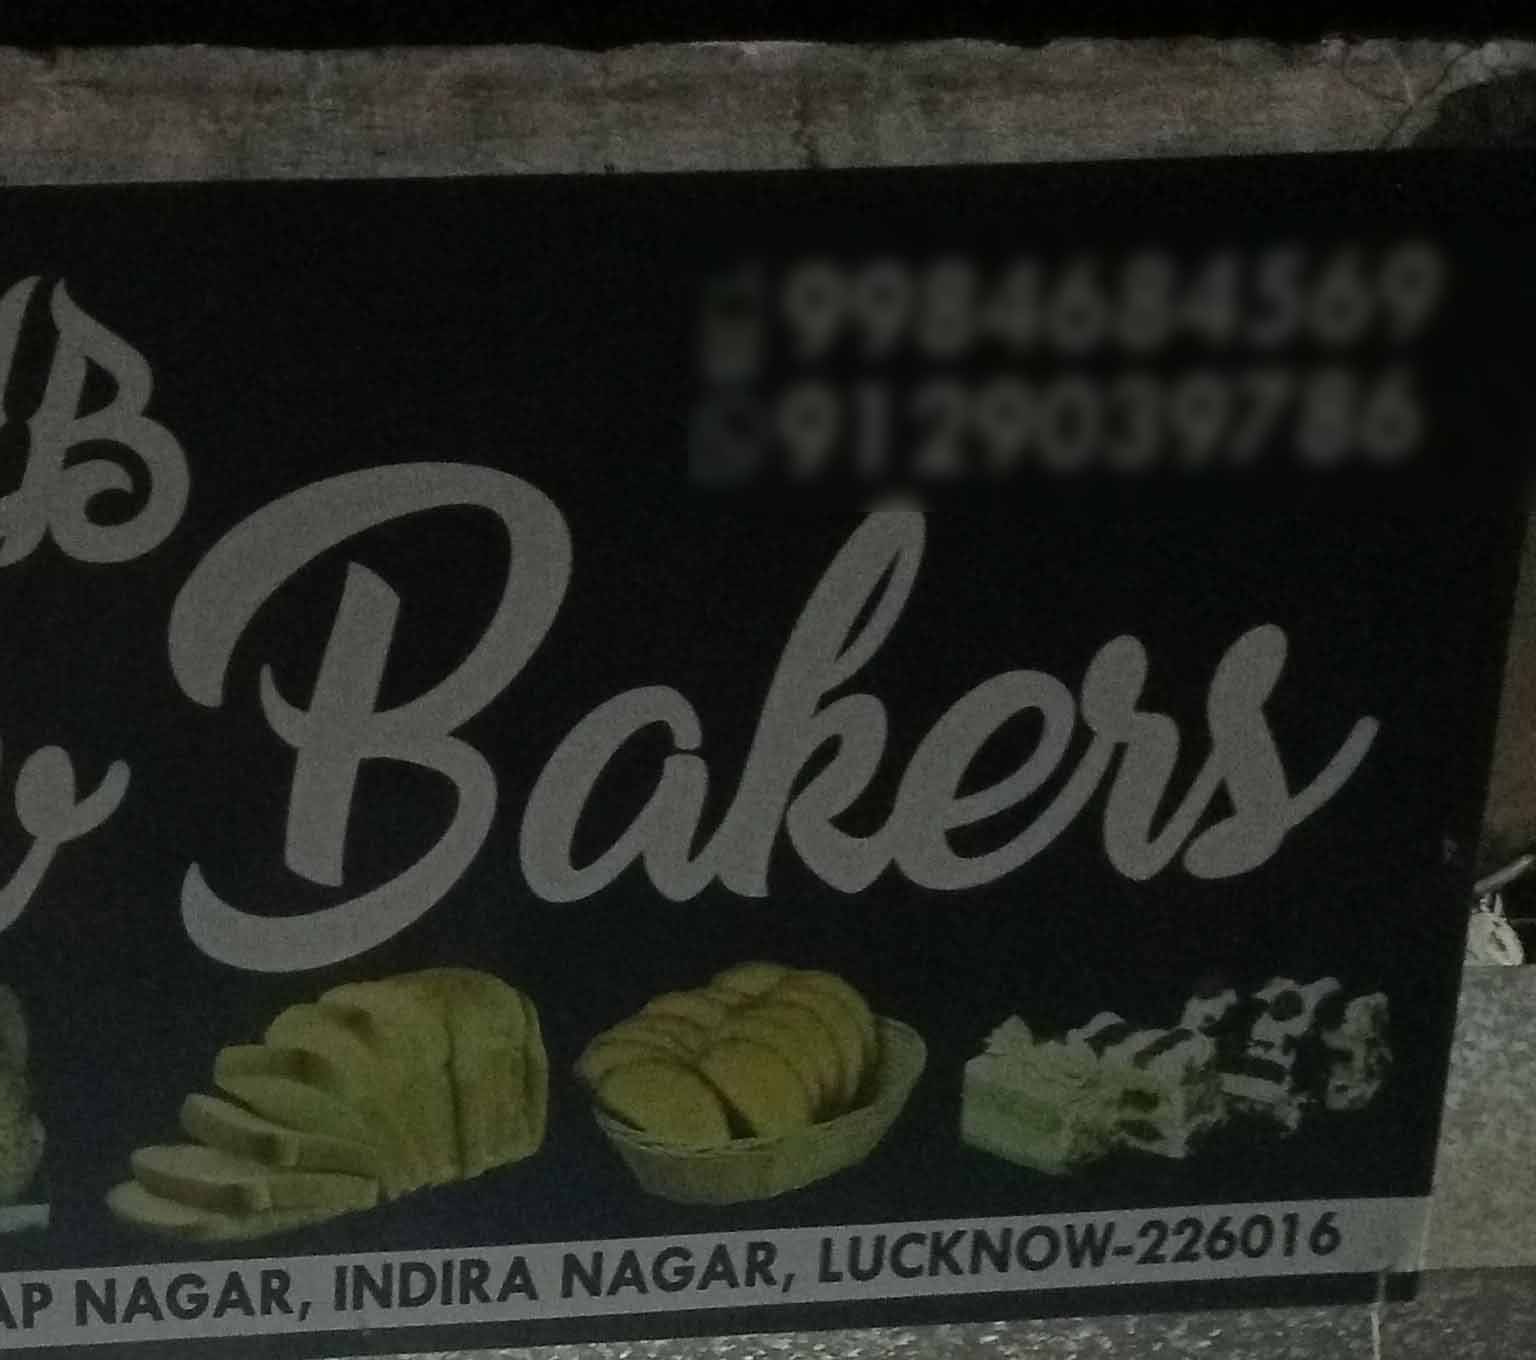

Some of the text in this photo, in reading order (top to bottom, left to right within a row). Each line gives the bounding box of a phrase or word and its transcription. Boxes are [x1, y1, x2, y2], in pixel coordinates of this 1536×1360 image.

[166, 460, 1381, 973] Bakers
[74, 1269, 311, 1326] NAGAR,
[334, 1255, 539, 1313] INDIRA
[560, 1240, 795, 1300] NAGAR,
[816, 1211, 1342, 1284] LUCKNOW-226016
